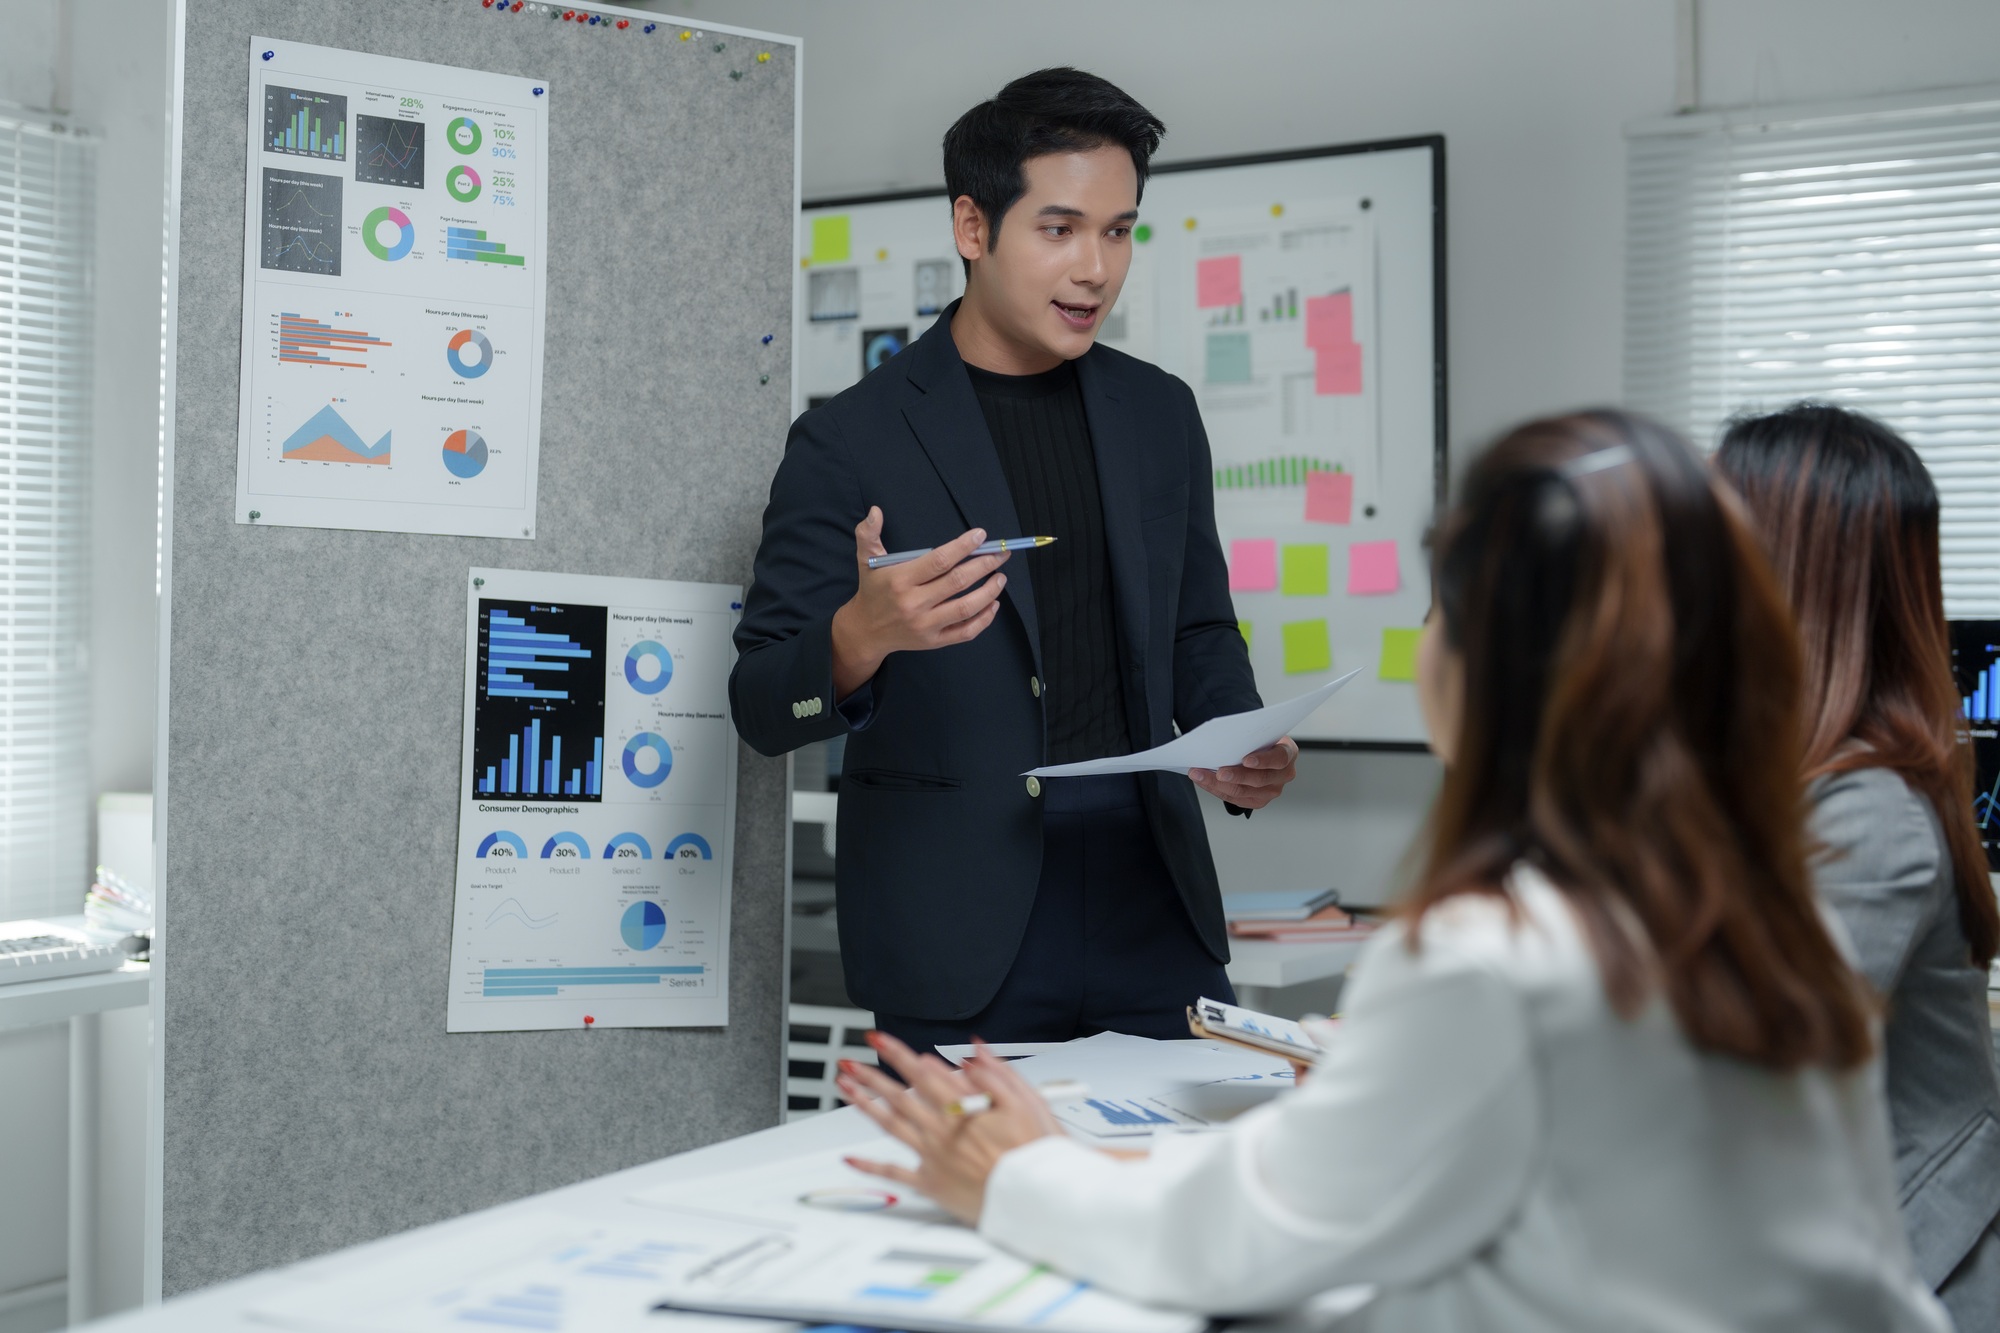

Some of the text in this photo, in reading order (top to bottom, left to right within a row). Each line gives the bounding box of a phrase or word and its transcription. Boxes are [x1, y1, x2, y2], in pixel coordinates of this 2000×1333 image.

[400, 97, 423, 109] 28%
[443, 104, 472, 113] Engagement
[493, 129, 515, 140] 10%
[492, 147, 516, 159] 90%
[493, 176, 515, 188] 25%
[493, 195, 515, 206] 75%
[479, 804, 579, 814] Consumer Demographics
[492, 848, 513, 856] 40%
[556, 849, 576, 857] 30%
[618, 849, 637, 857] 20%
[680, 850, 697, 858] 10%
[612, 867, 634, 875] Service
[669, 978, 704, 987] Series 1
